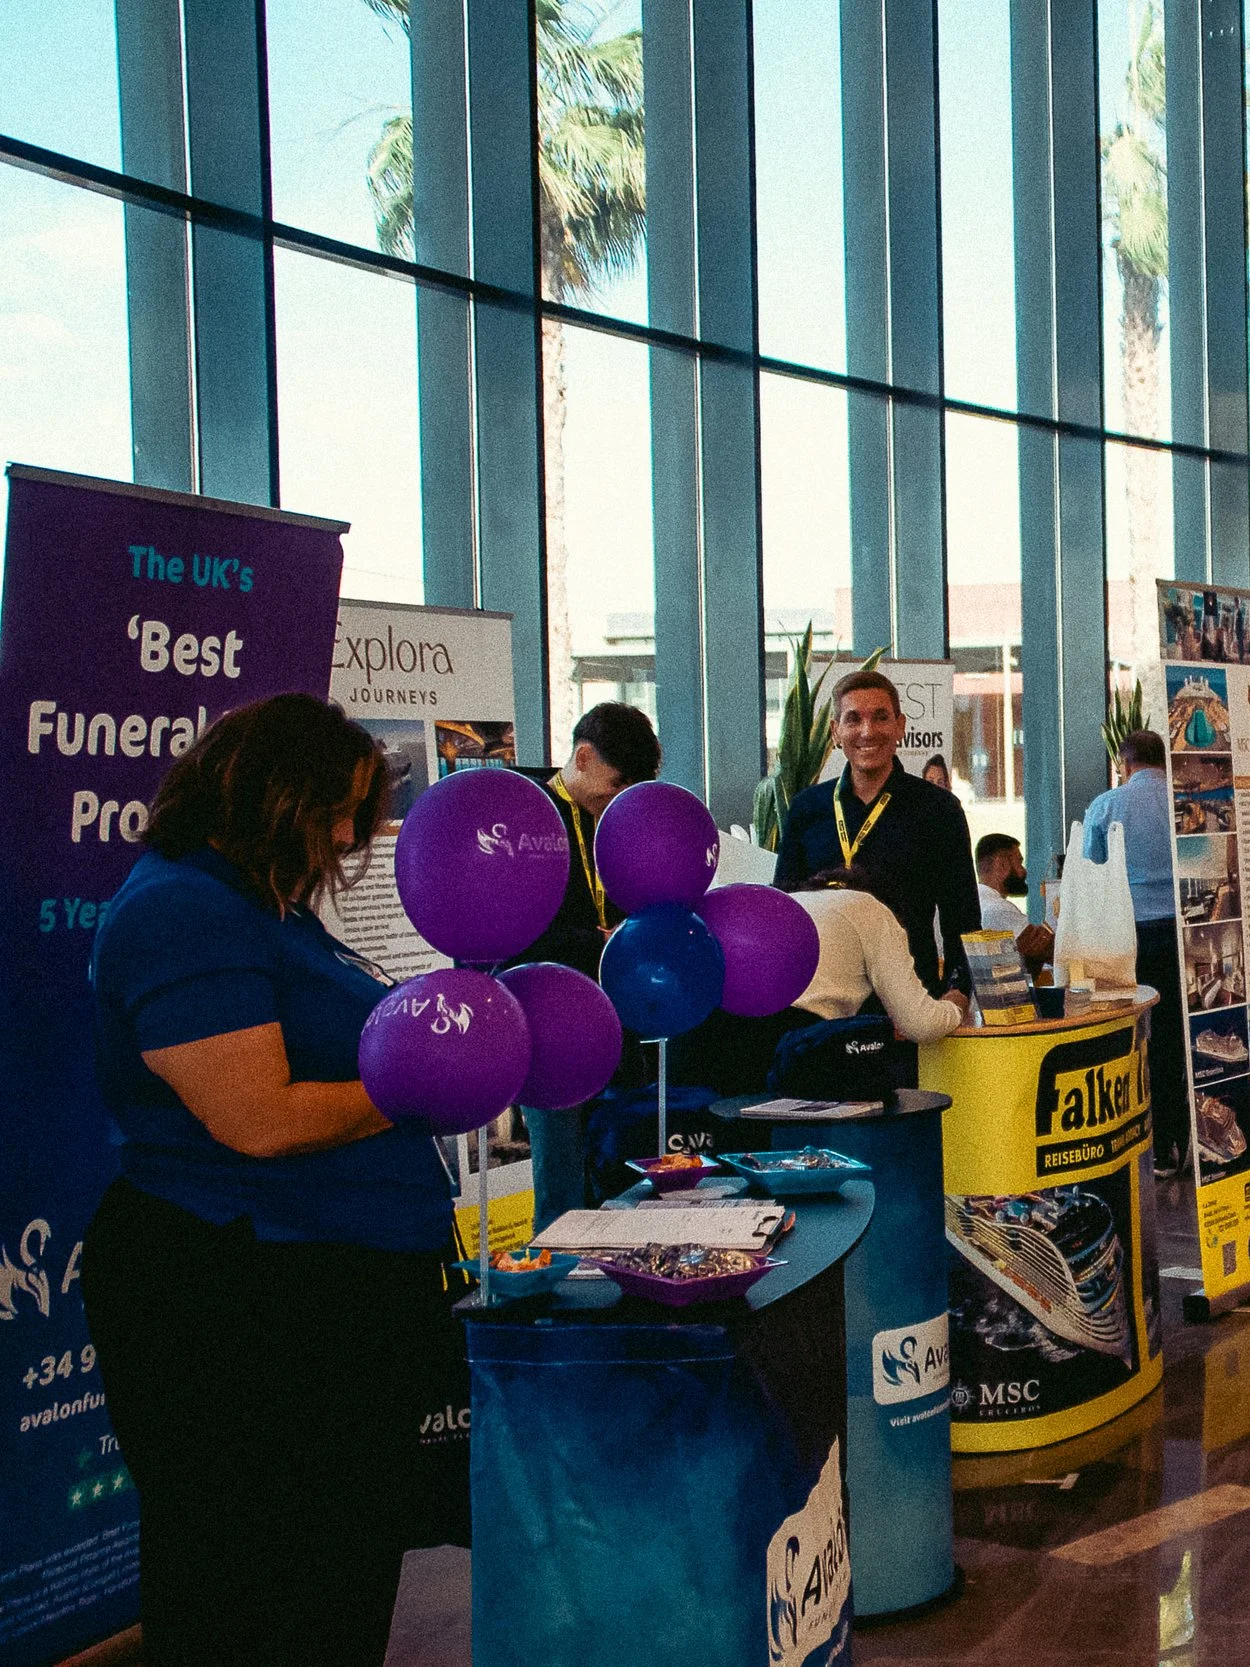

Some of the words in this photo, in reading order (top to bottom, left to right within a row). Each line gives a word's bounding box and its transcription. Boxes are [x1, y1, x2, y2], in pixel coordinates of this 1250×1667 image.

[128, 545, 184, 584] The
[193, 555, 255, 593] UK's
[349, 687, 438, 705] JOURNEYS
[28, 701, 206, 758] Funeral
[39, 899, 56, 933] 5
[1044, 1143, 1105, 1168] REISEBÜRO
[22, 1349, 74, 1390] +34
[79, 1343, 98, 1374] 9
[979, 1379, 1040, 1406] MSC
[889, 1415, 911, 1428] Visit
